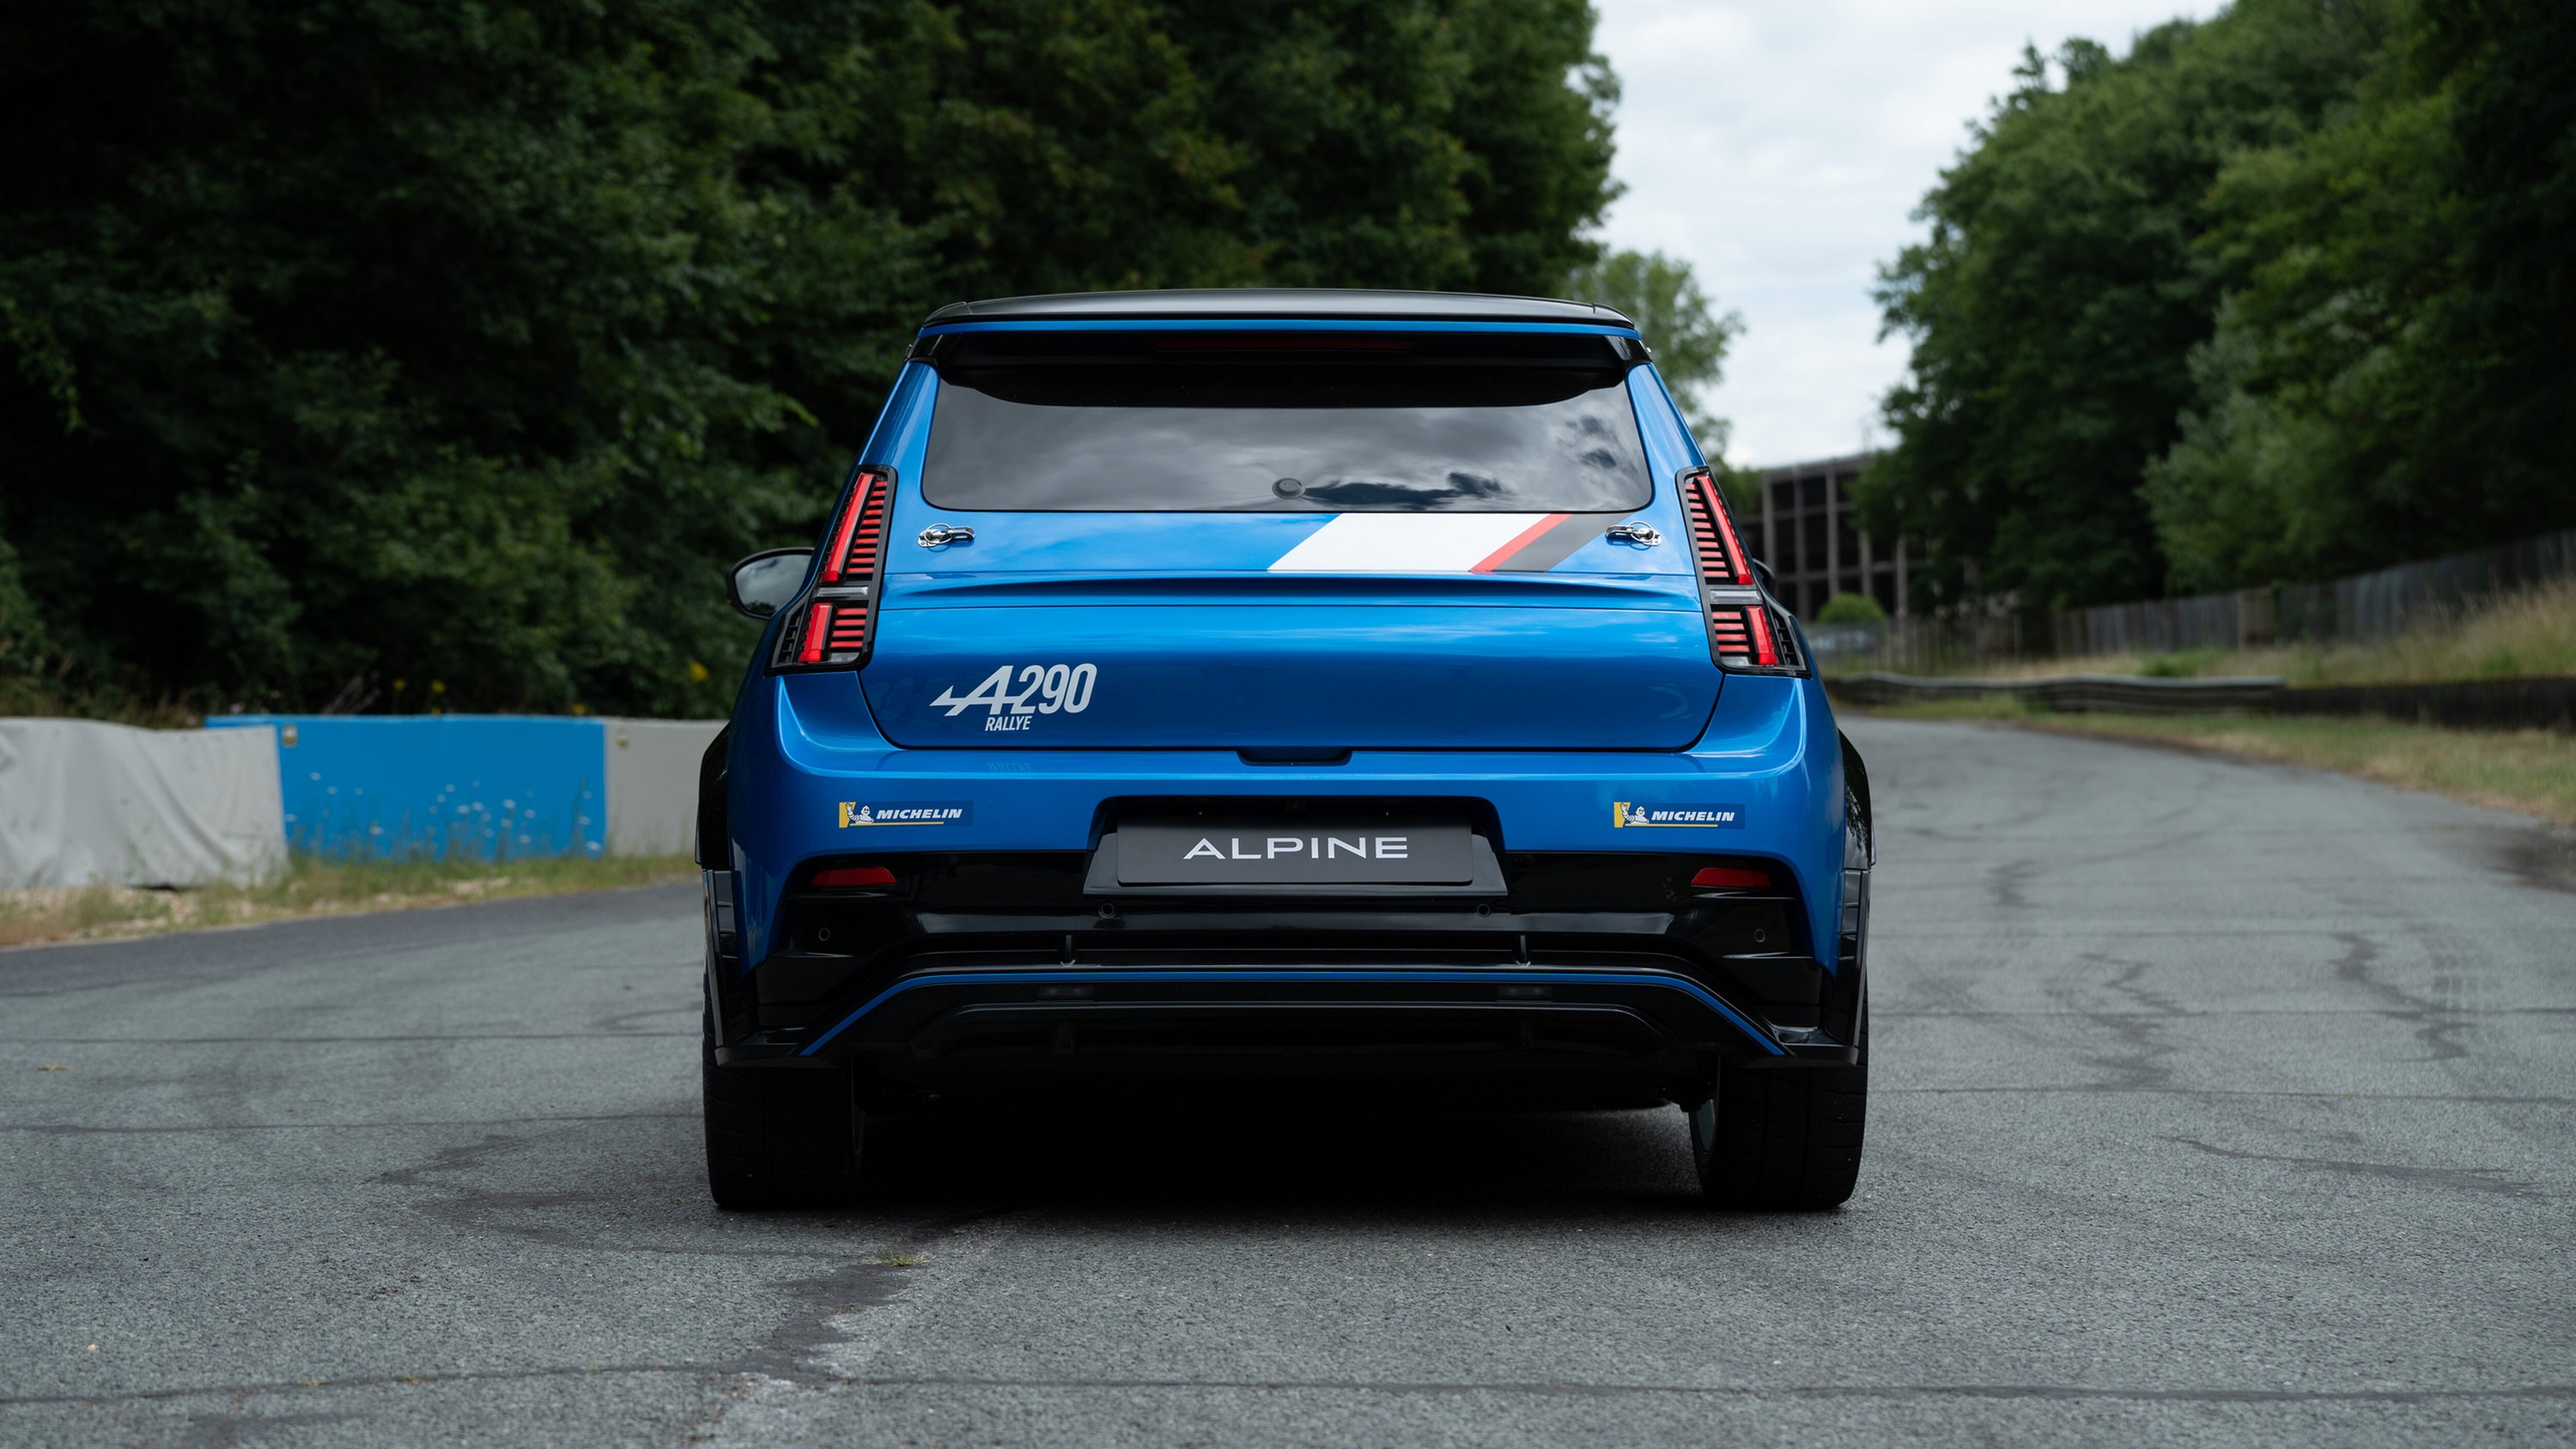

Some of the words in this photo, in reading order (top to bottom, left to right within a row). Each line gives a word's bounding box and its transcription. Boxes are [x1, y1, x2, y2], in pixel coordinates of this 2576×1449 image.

[929, 663, 1097, 717] A290
[985, 716, 1032, 731] RALLYE
[876, 809, 963, 820] MICHELIN
[1651, 810, 1735, 822] MICHELIN
[1183, 837, 1408, 859] ALPINE
